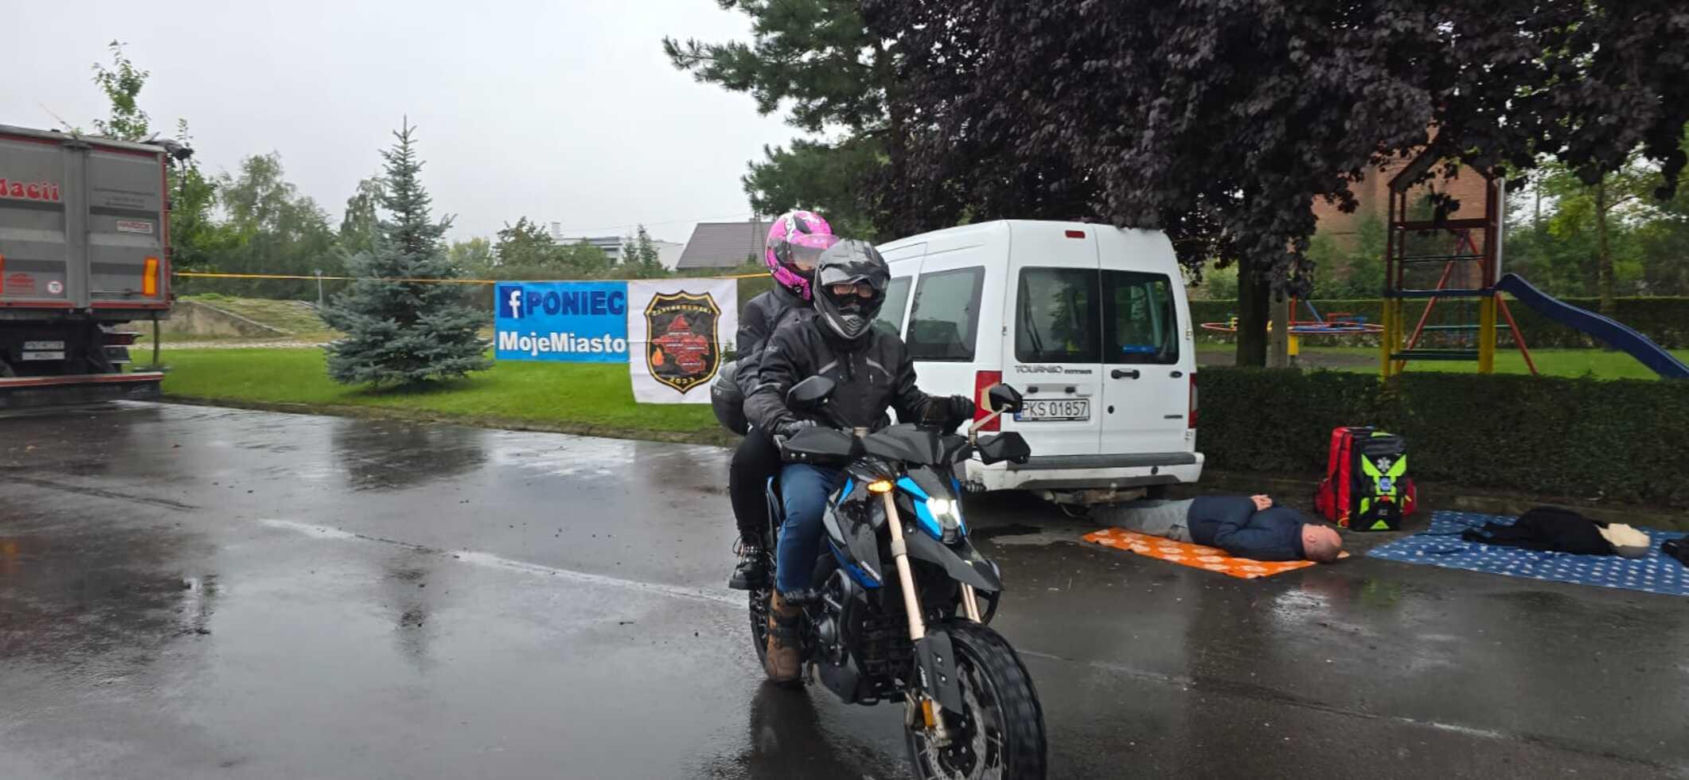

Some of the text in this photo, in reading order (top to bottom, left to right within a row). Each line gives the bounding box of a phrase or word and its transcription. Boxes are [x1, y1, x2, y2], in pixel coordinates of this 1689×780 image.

[526, 291, 624, 316] PONIEC
[499, 331, 626, 356] MojeMiasto
[1022, 401, 1087, 416] PKS 01857
